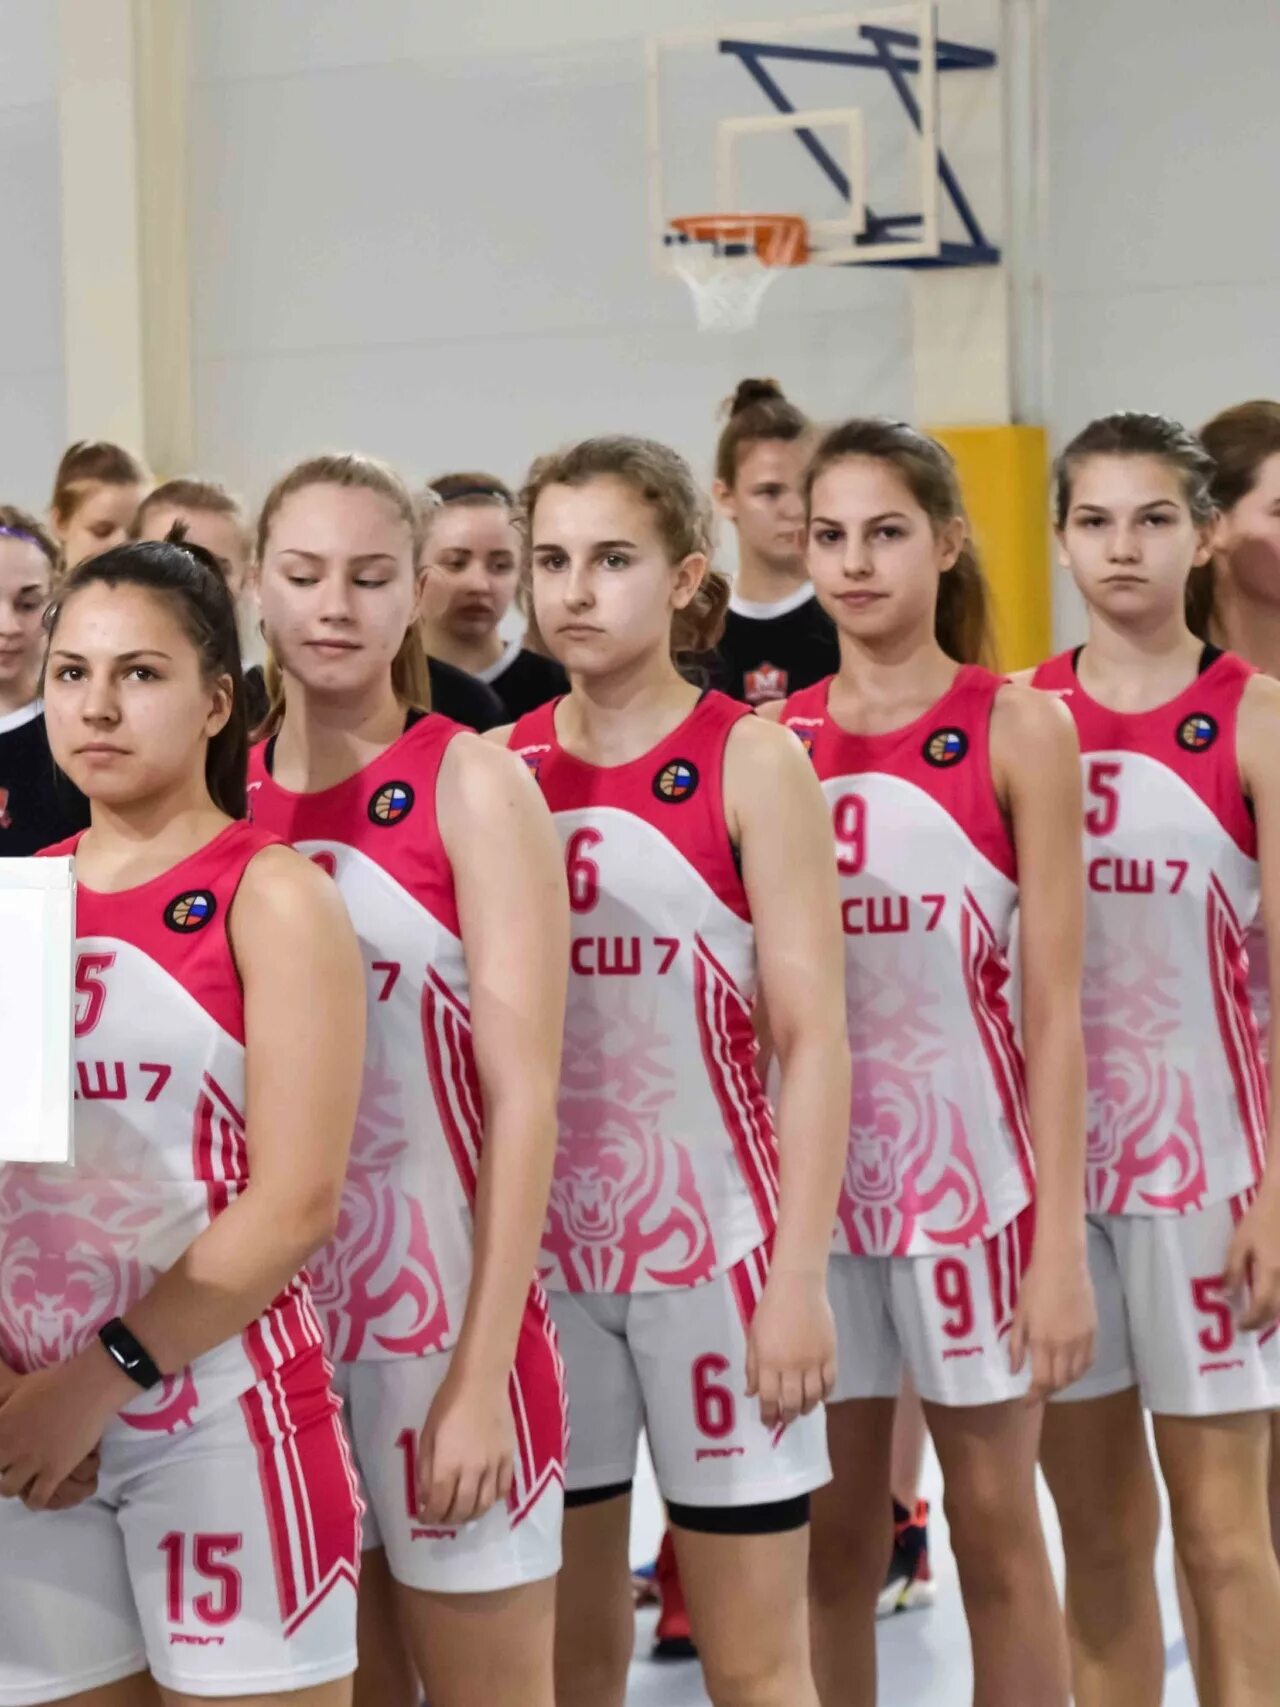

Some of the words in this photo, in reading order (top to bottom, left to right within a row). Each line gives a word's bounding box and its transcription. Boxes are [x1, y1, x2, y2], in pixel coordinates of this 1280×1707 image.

[833, 794, 867, 877] 9
[1085, 762, 1122, 837] 5
[565, 827, 604, 914] 6
[1088, 857, 1154, 893] СШ
[1165, 860, 1189, 894] 7
[841, 896, 909, 935] СШ
[921, 894, 945, 932] 7
[75, 951, 117, 1038] 5
[372, 961, 401, 1002] 7
[571, 937, 641, 976] СШ
[653, 937, 680, 975] 7
[74, 1061, 128, 1100] Ш
[139, 1062, 172, 1102] 7
[934, 1257, 974, 1339] 9
[1190, 1275, 1234, 1354] 5
[691, 1351, 736, 1440] 6
[394, 1427, 419, 1520] 1
[157, 1530, 243, 1628] 15
